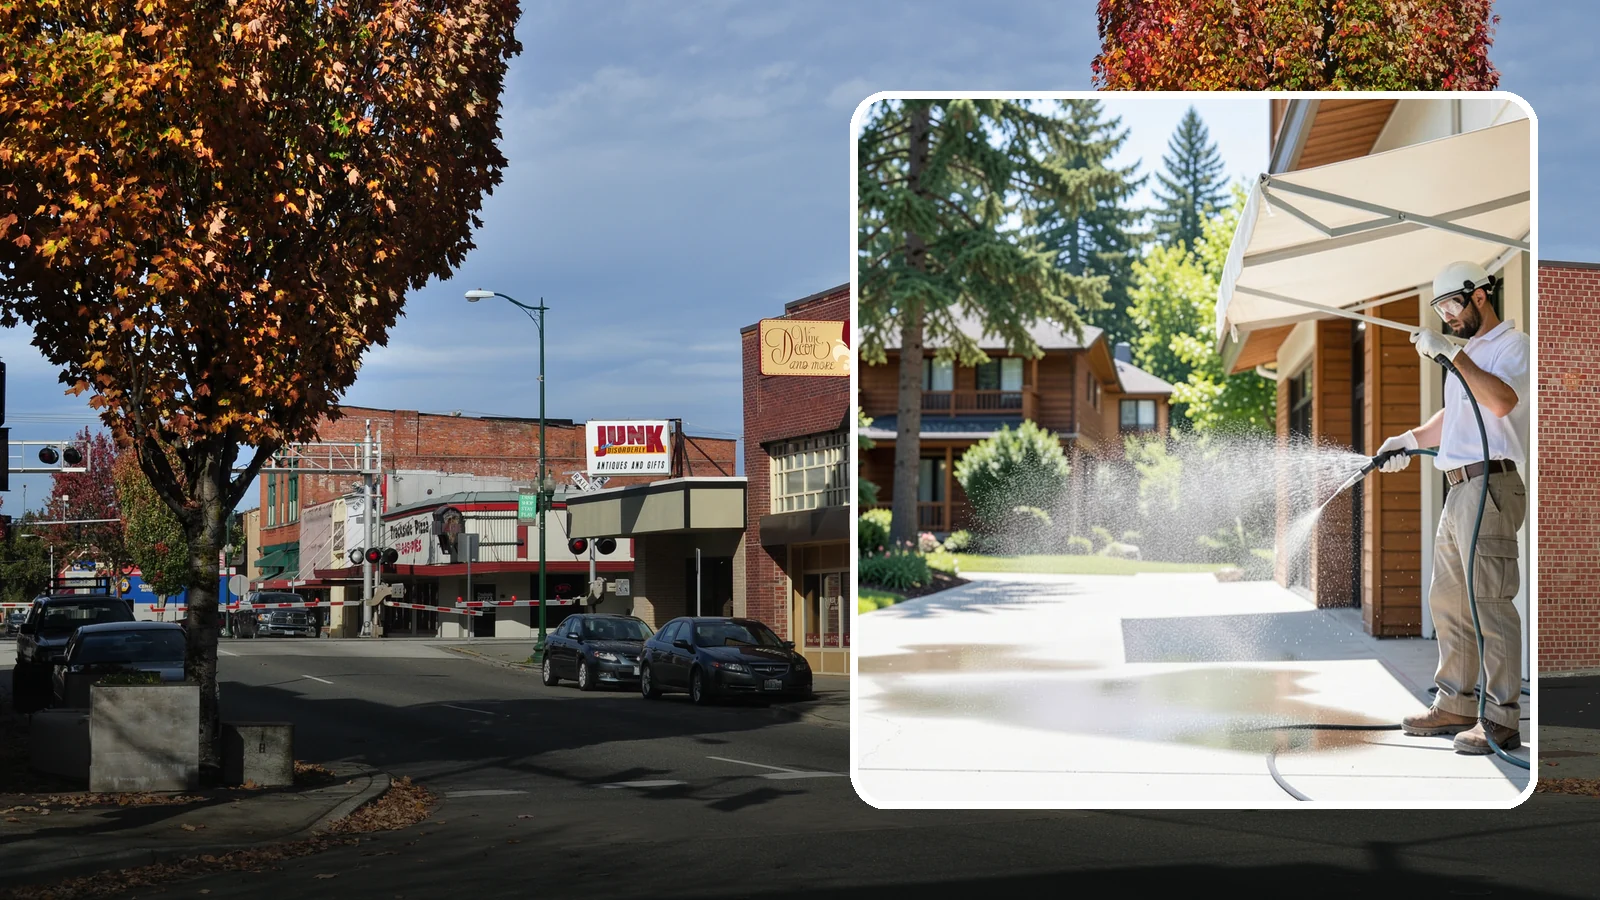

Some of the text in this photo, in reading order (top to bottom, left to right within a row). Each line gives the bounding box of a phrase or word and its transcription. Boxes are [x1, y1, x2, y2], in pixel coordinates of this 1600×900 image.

[595, 425, 666, 457] JUNK
[596, 460, 666, 470] ANTIQUES AND GIFTS
[390, 519, 429, 540] Trackside Pizza
